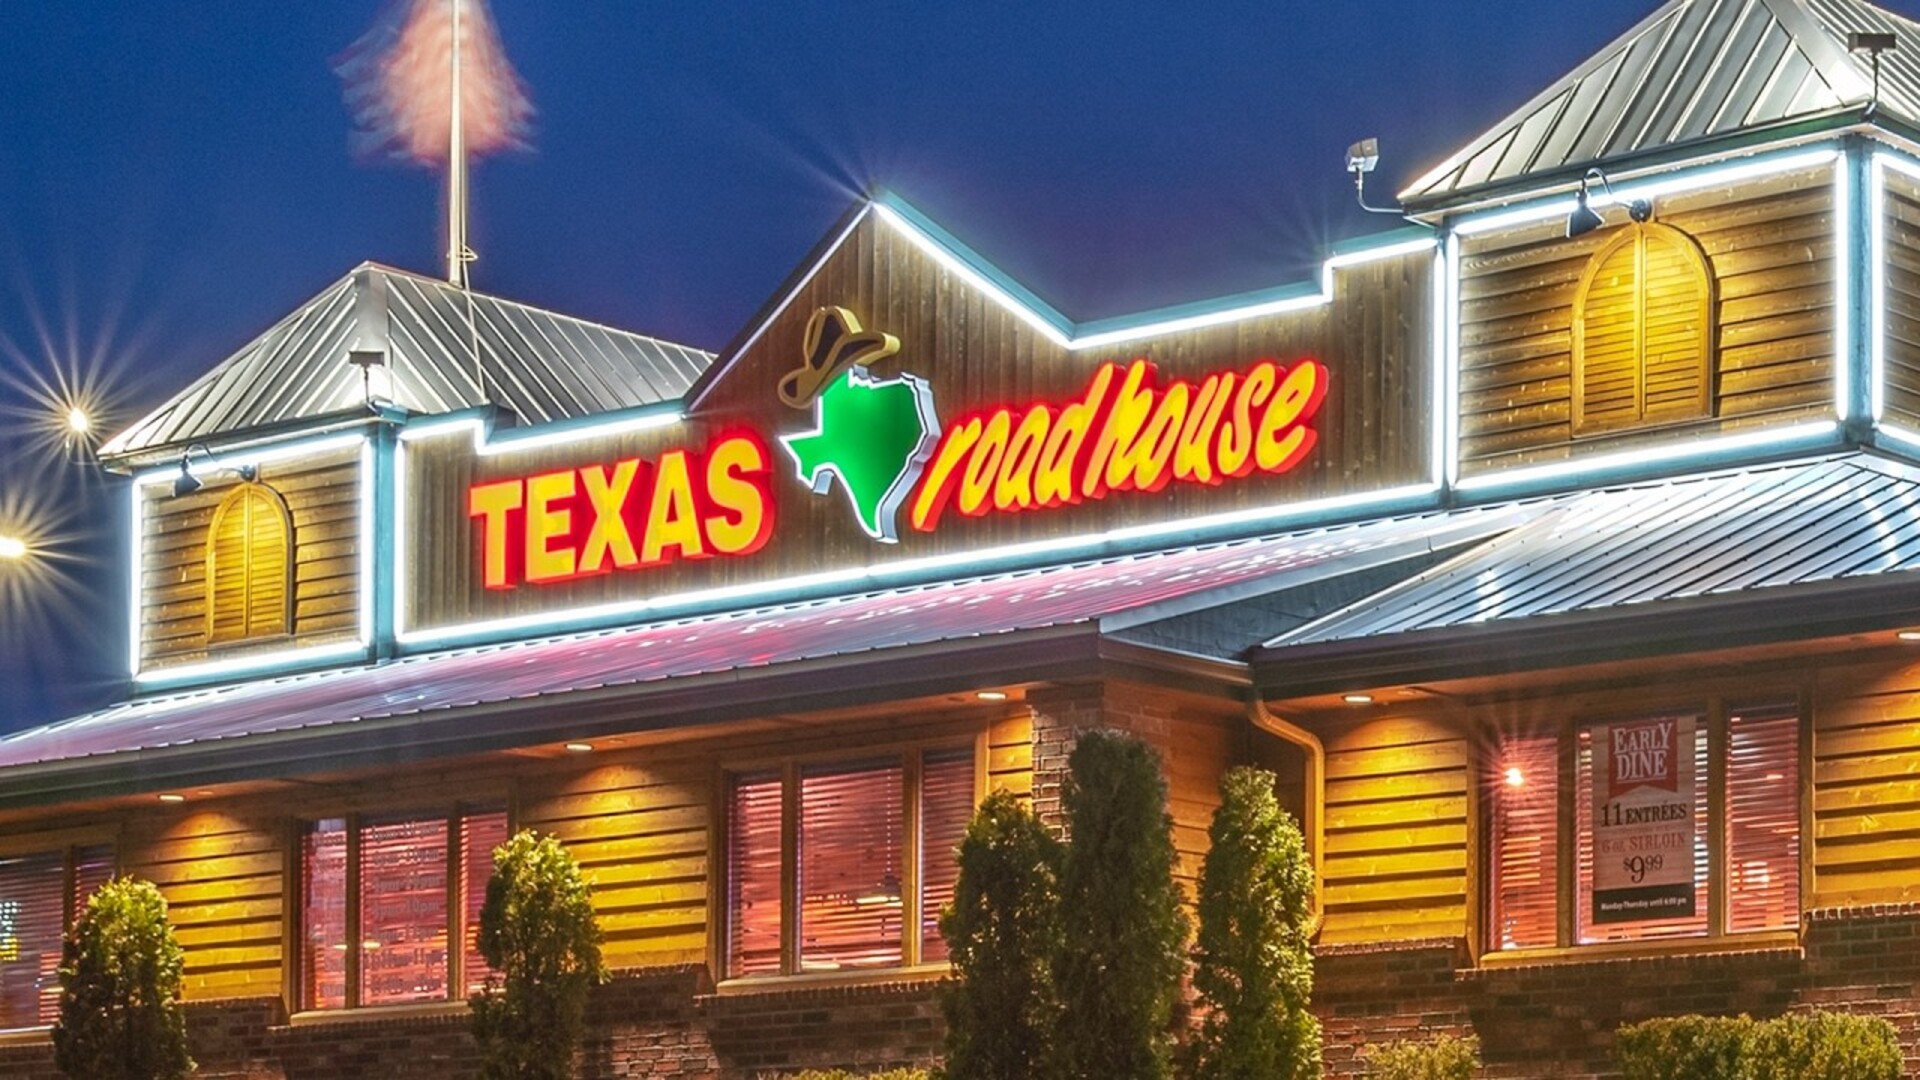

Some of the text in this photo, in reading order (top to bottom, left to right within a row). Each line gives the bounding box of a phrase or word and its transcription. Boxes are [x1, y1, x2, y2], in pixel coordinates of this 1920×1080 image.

[468, 359, 1328, 588] TEXAS roadhouse
[1613, 723, 1672, 754] EARLY
[1616, 749, 1667, 780] DINE
[1601, 801, 1687, 827] 11 ENTRÉES
[1602, 840, 1610, 853] 6
[1629, 832, 1685, 851] SIRLOIN
